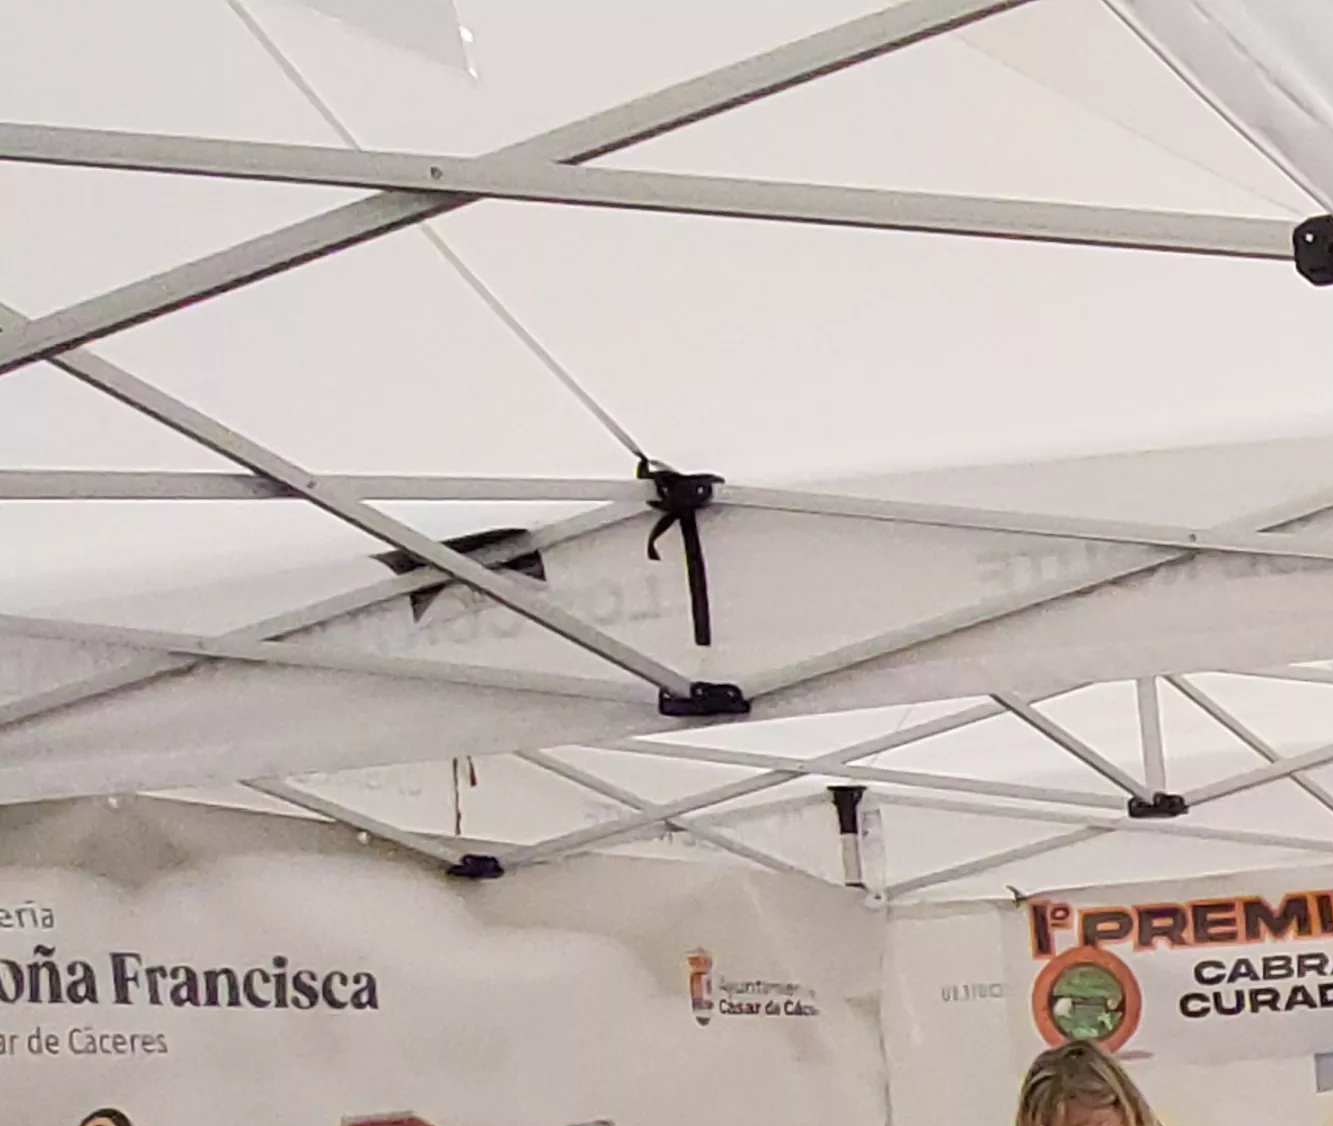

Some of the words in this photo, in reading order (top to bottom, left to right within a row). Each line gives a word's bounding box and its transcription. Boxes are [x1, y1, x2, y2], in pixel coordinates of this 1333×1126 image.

[109, 952, 379, 1010] Francisca
[719, 999, 760, 1016] Casar
[28, 1026, 60, 1055] de
[69, 1026, 168, 1055] Cáceres
